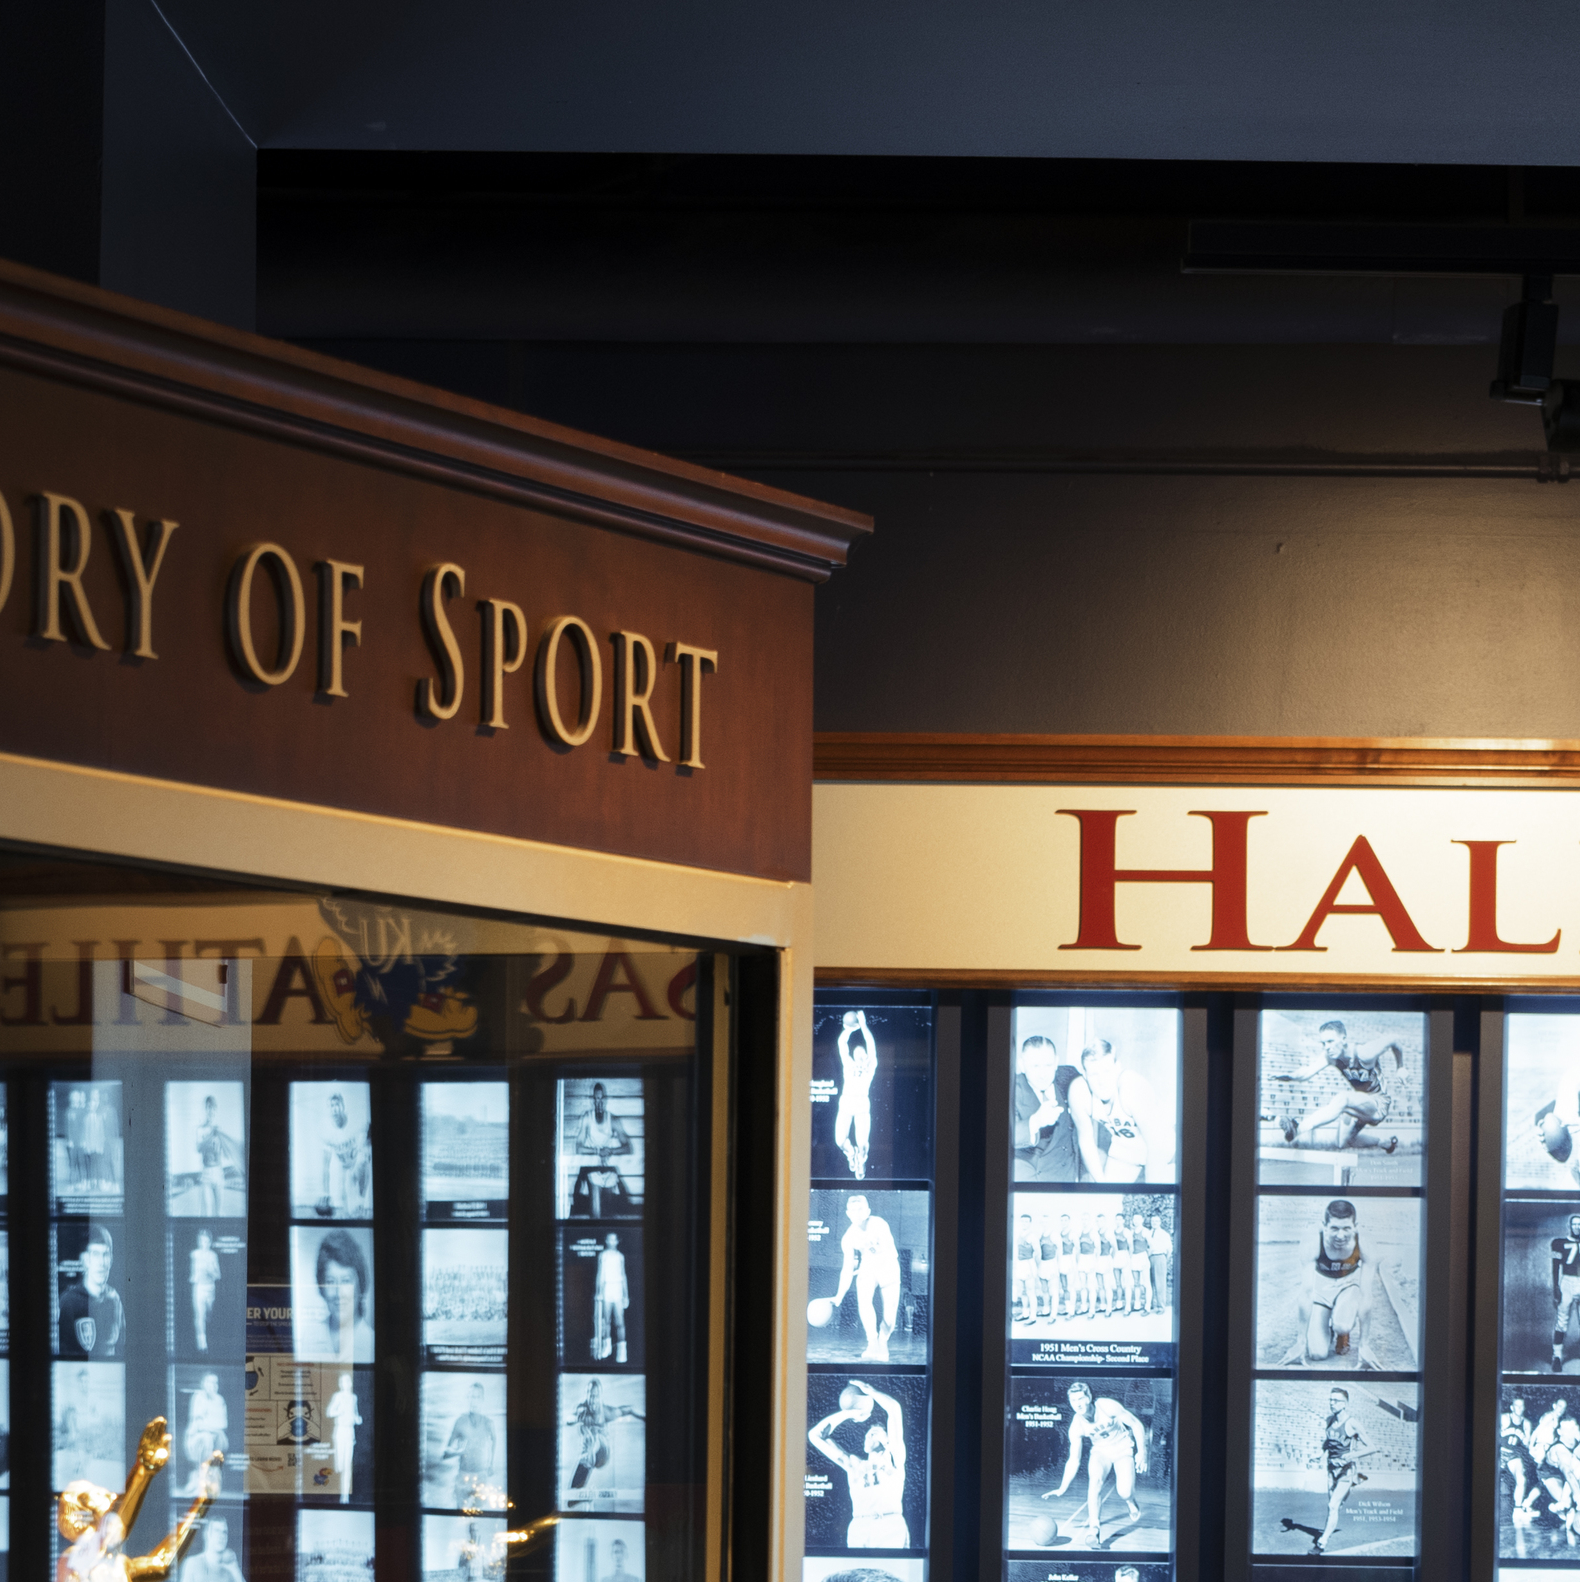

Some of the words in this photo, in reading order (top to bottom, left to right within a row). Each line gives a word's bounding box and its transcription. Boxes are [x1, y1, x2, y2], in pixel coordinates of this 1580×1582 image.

[228, 541, 366, 698] OF
[420, 561, 719, 769] SPORT
[1040, 1343, 1058, 1352] 1951
[1060, 1343, 1085, 1352] Men's
[1086, 1343, 1108, 1352] Cross
[1109, 1344, 1141, 1354] Country
